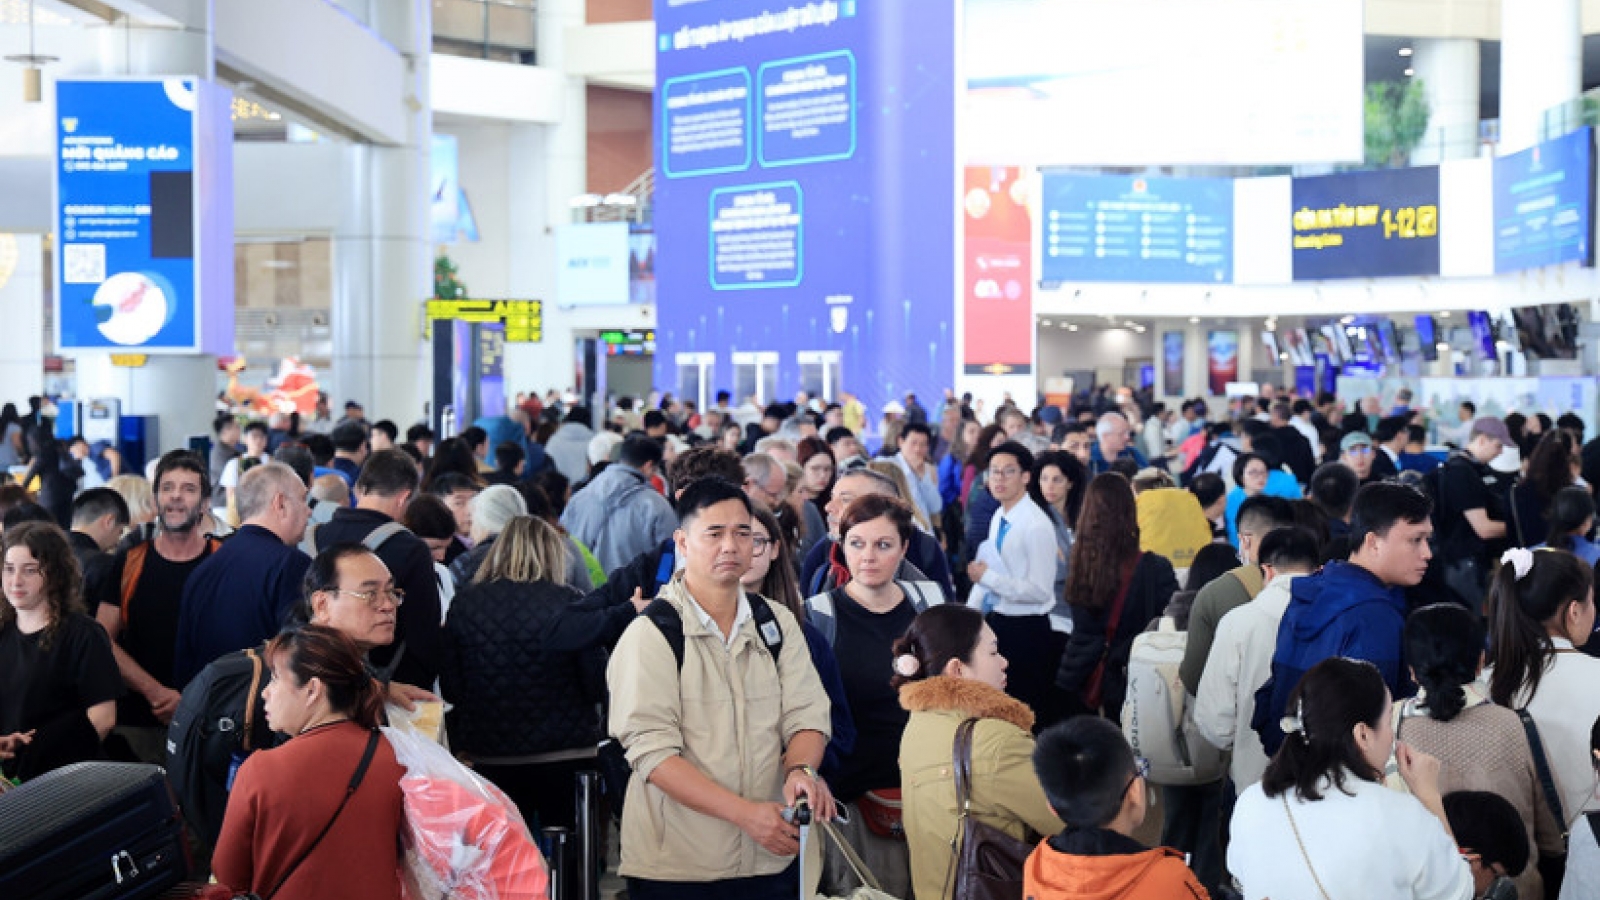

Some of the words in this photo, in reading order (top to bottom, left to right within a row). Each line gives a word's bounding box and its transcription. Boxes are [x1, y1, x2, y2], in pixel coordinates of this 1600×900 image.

[93, 143, 145, 161] QUẢNG
[146, 143, 179, 161] CÁO
[1381, 207, 1416, 239] 1-12
